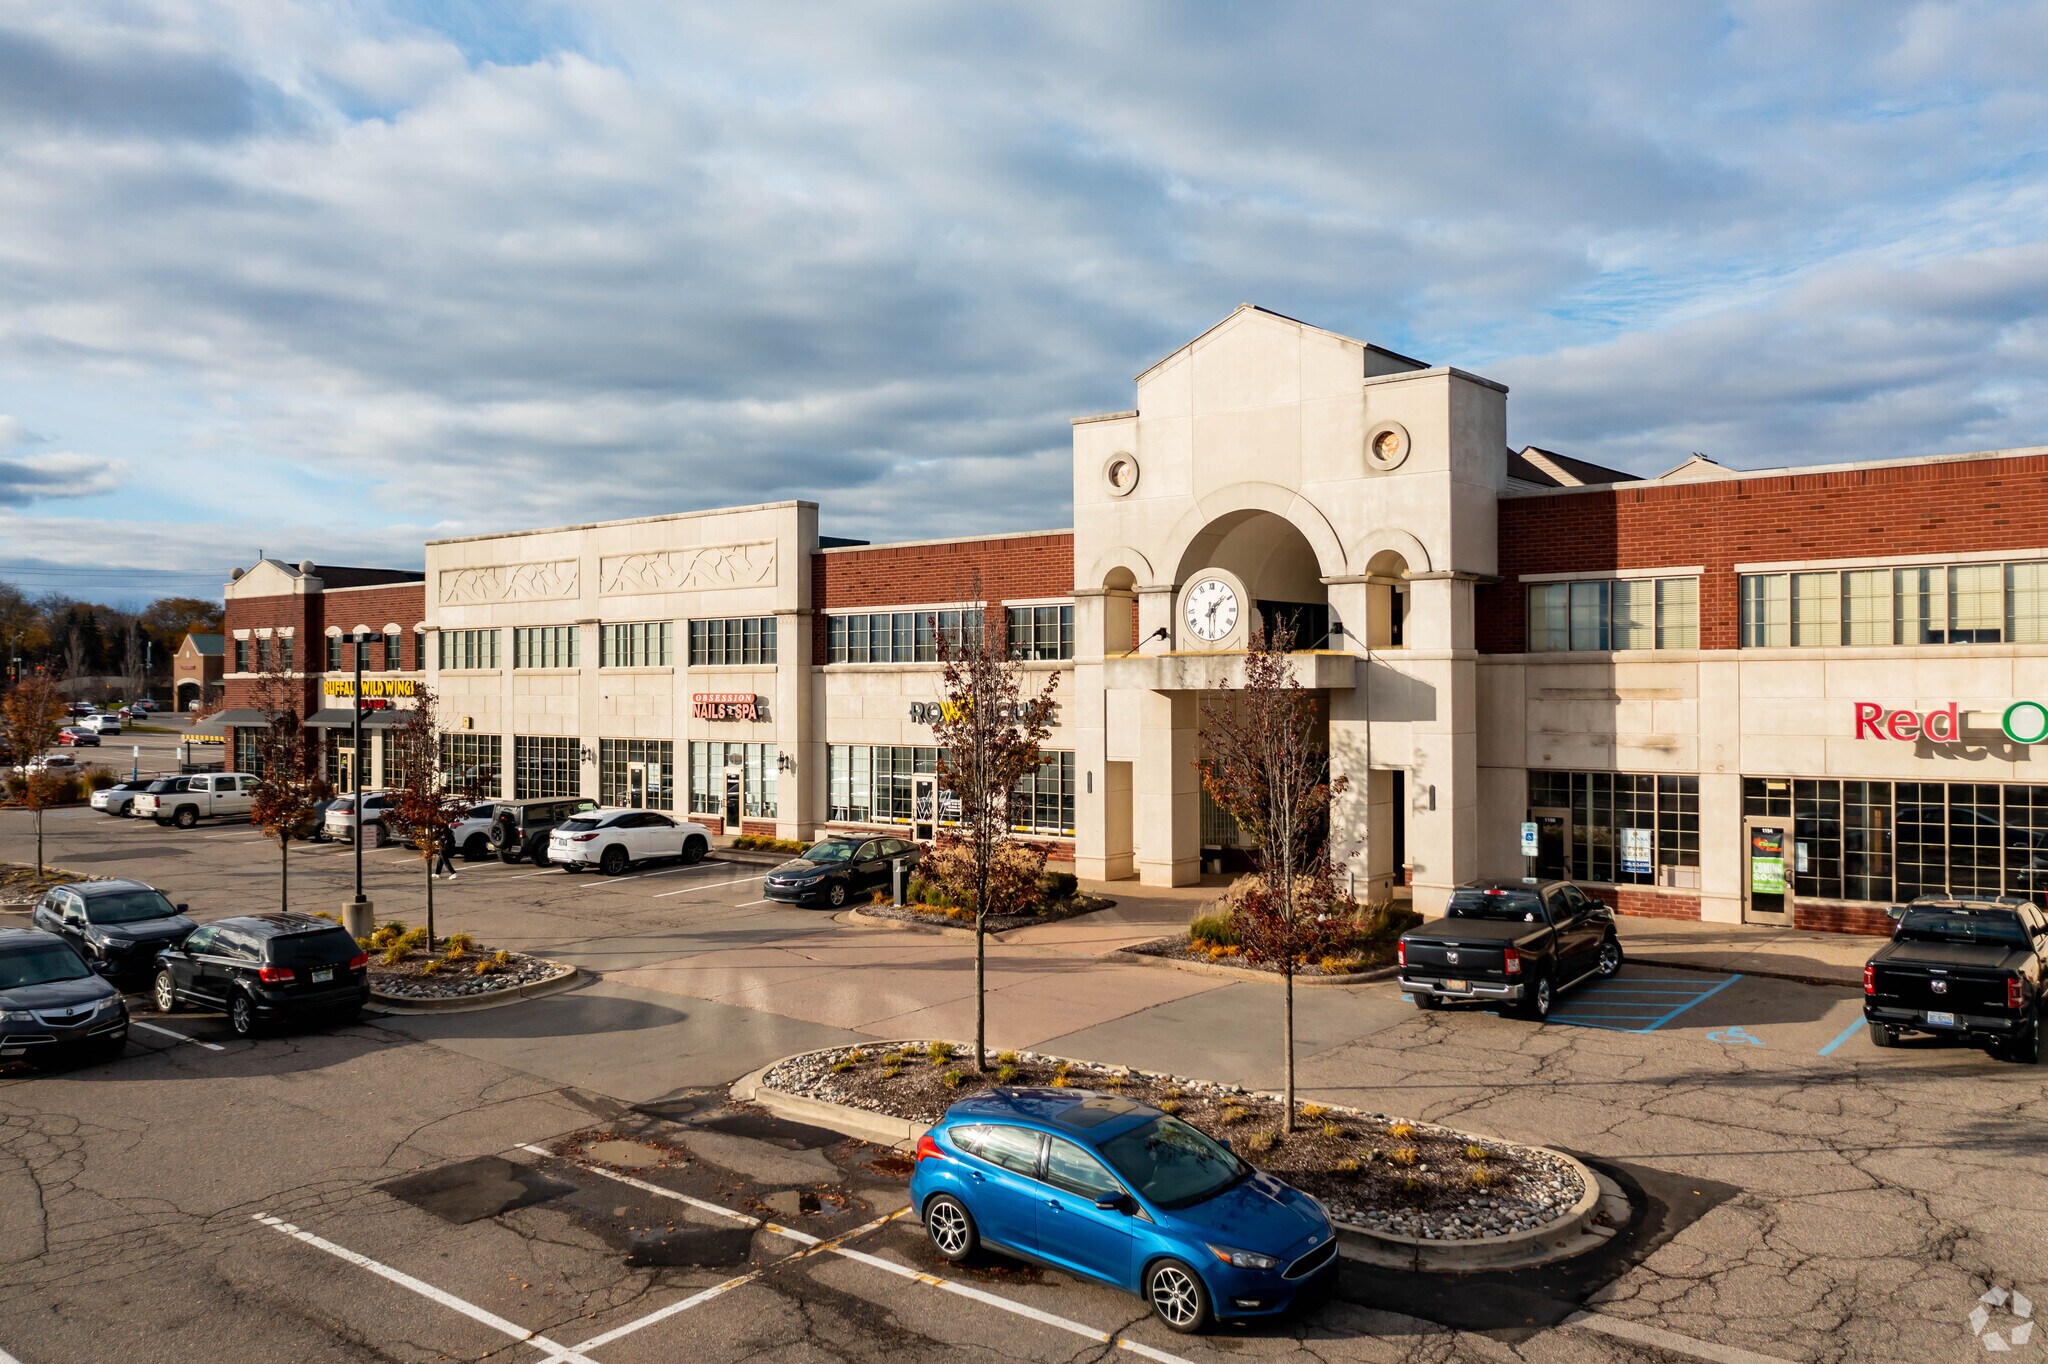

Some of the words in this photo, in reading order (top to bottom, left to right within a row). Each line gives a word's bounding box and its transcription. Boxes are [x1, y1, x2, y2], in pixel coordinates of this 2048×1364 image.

[324, 681, 358, 695] BUFFAL
[361, 681, 384, 695] WILD
[384, 681, 415, 695] WINGS
[695, 694, 752, 702] OBSESSION
[693, 702, 726, 719] NAILS
[735, 703, 756, 719] SPA
[1853, 701, 1961, 743] Red
[1753, 862, 1783, 873] COMING
